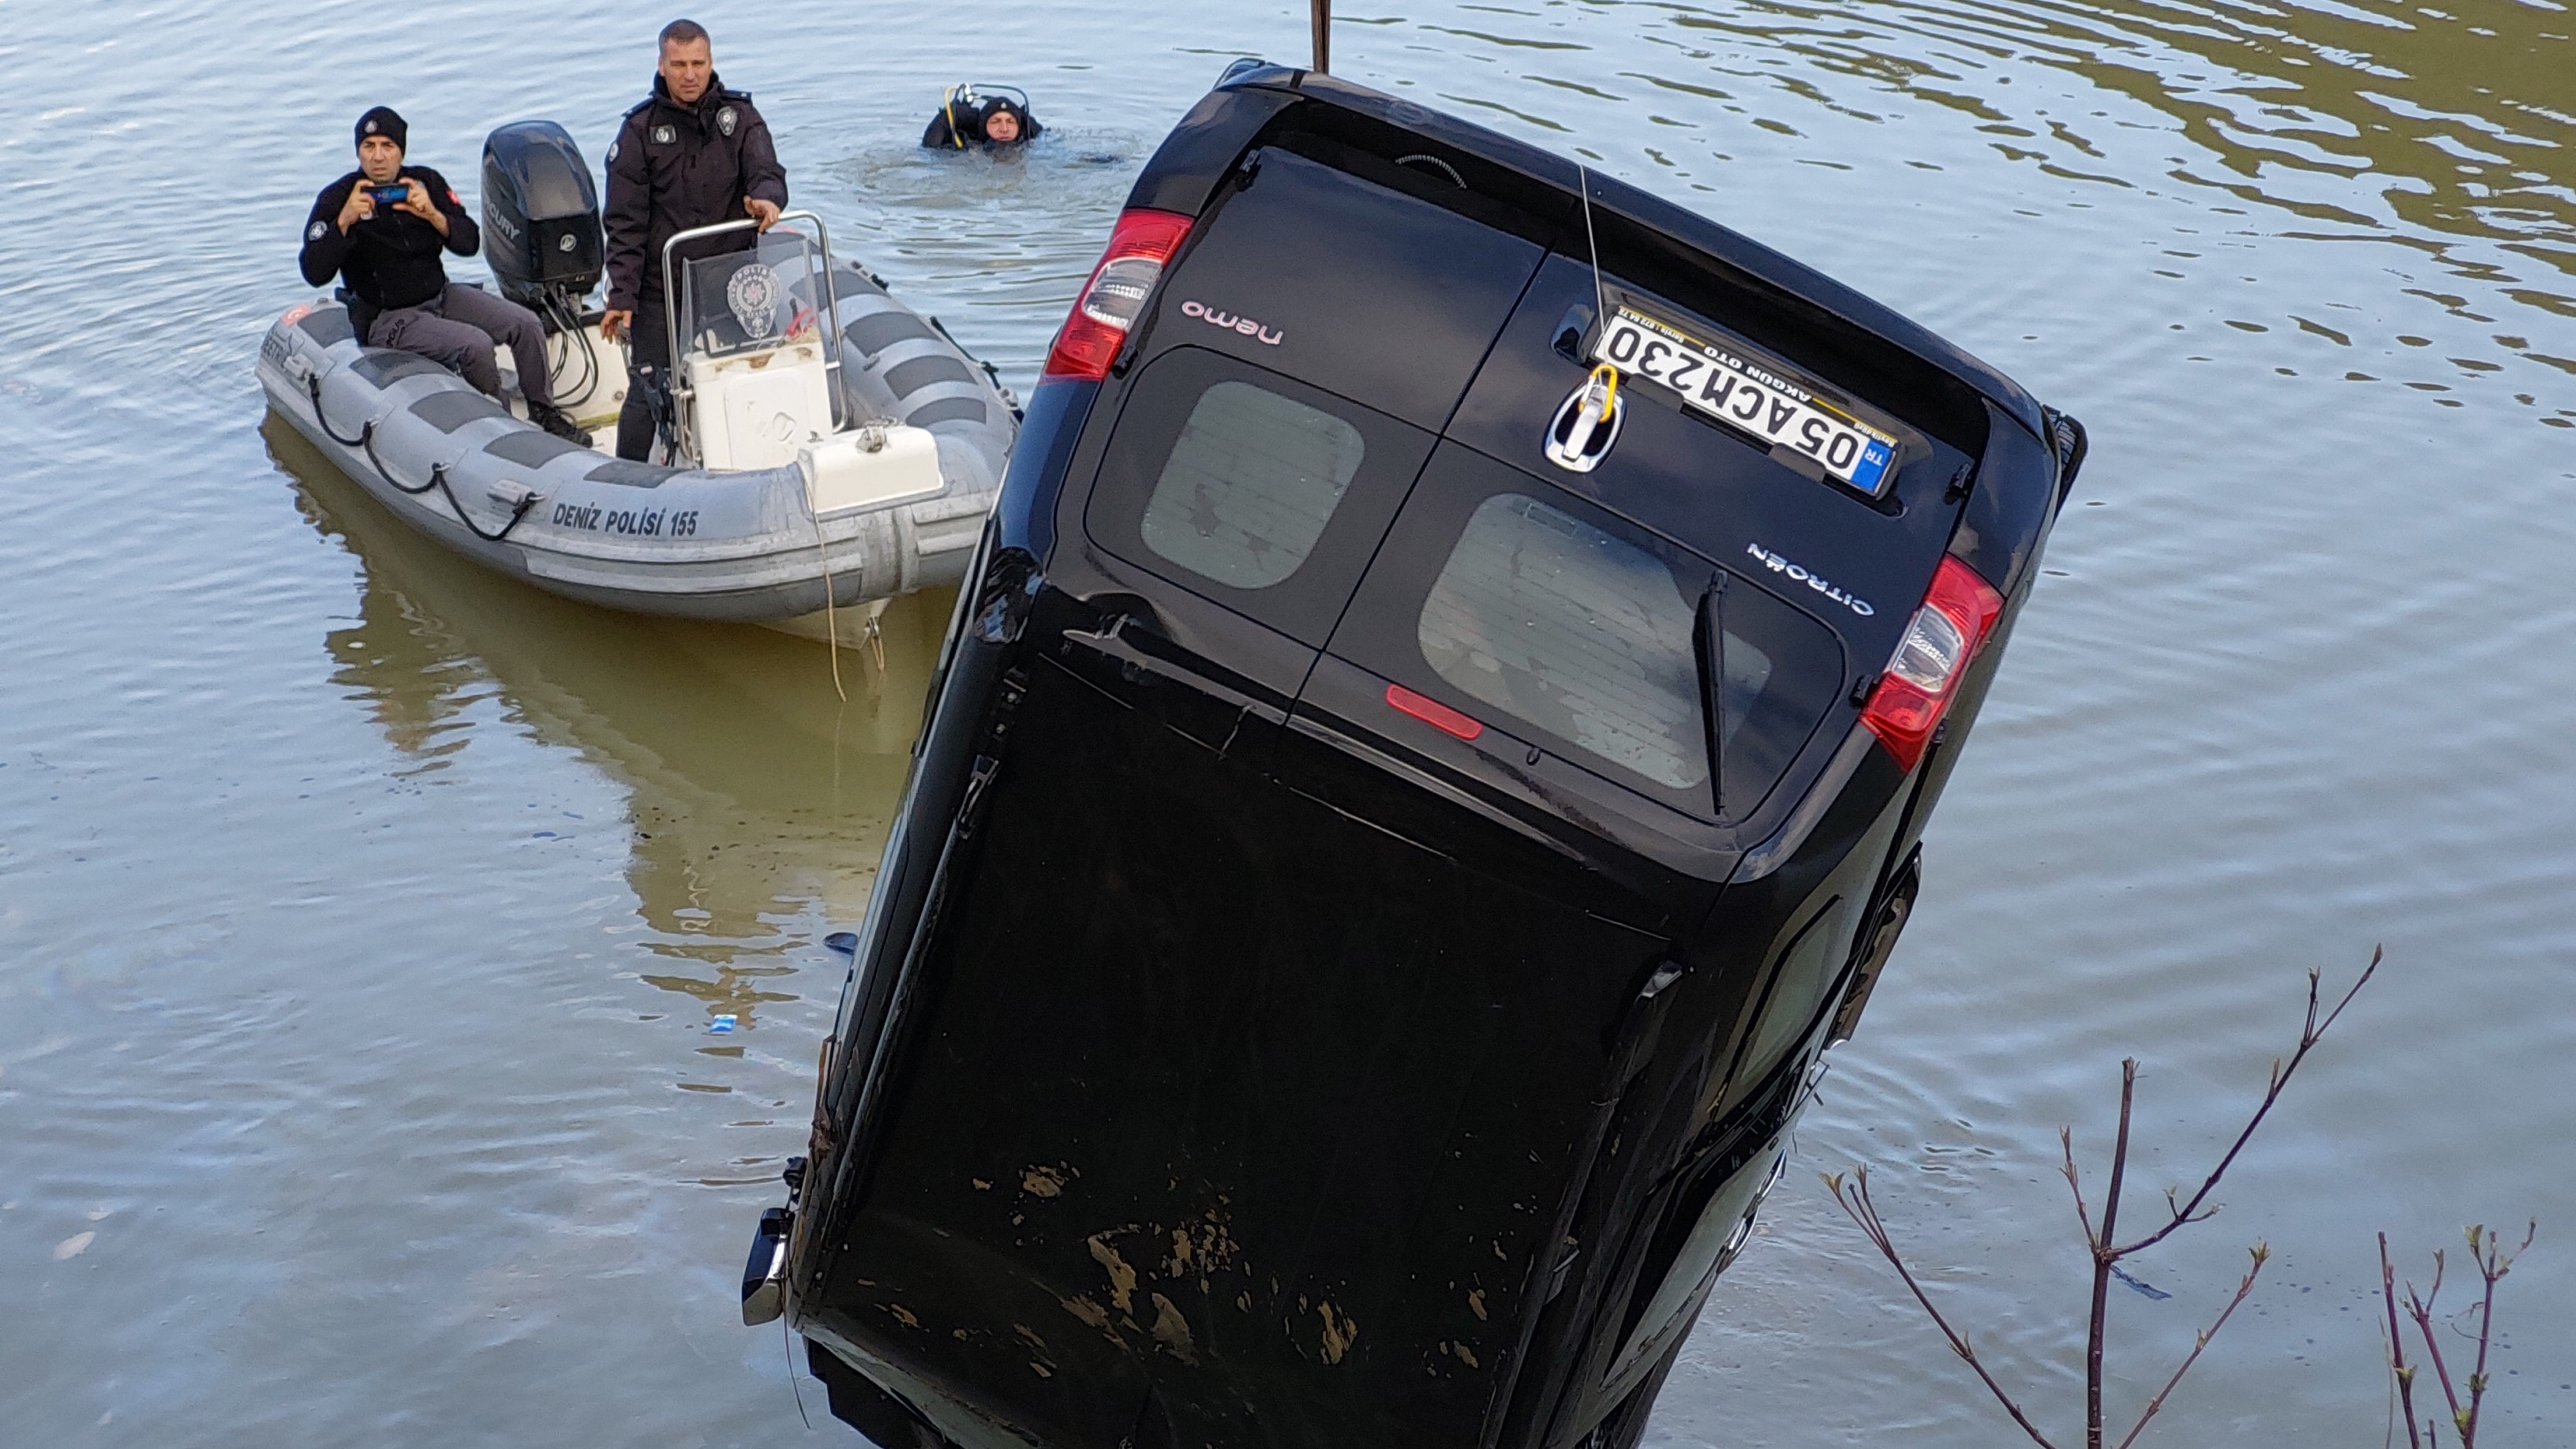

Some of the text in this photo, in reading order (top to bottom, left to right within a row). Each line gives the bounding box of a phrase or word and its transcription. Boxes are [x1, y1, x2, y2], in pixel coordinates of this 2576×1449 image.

[1181, 301, 1284, 346] nemo
[1608, 326, 1859, 470] 05 ACM 230
[1704, 346, 1813, 402] AKGÜN OTO
[1865, 447, 1885, 467] TR
[552, 501, 699, 537] DENİZ POLİSİ 155
[1747, 542, 1875, 616] CITROËN
